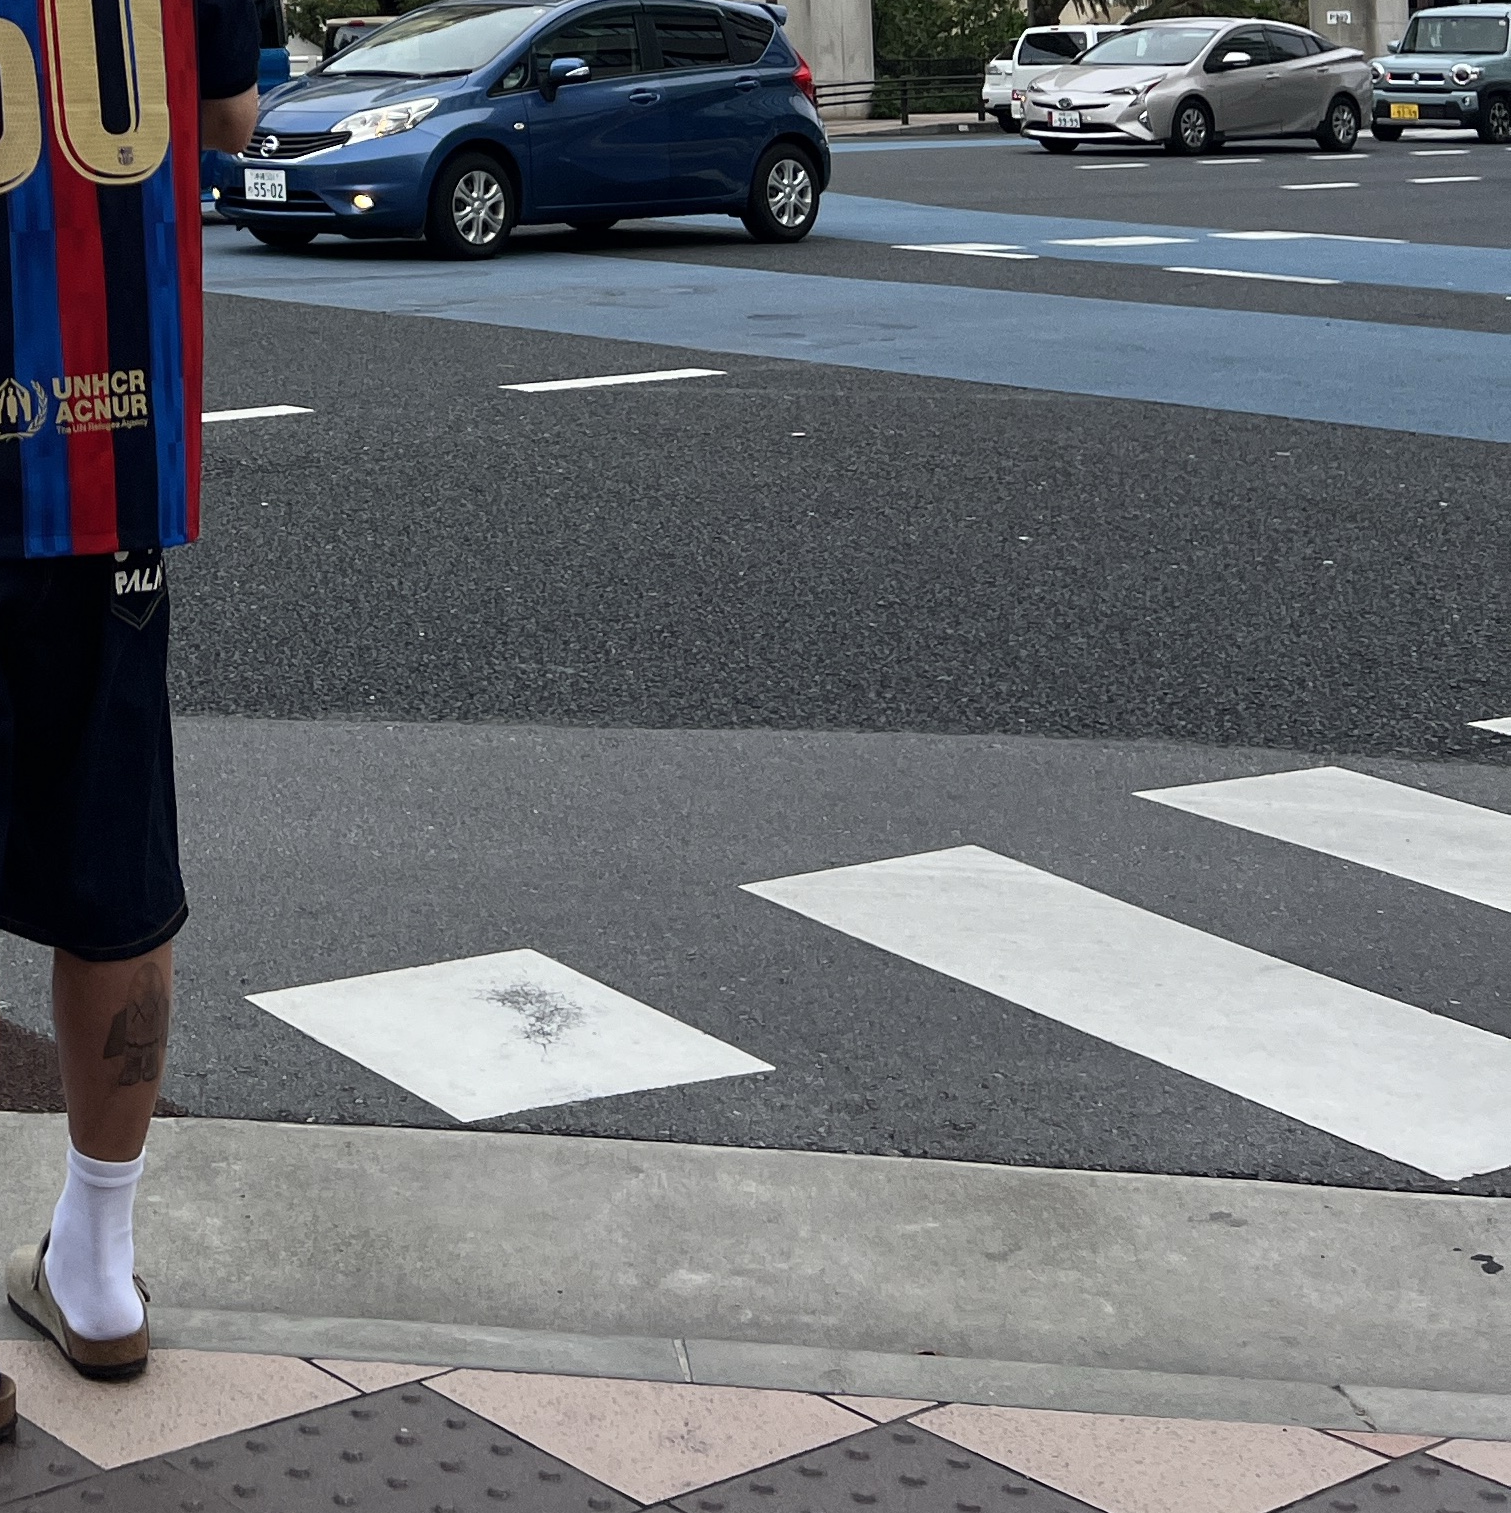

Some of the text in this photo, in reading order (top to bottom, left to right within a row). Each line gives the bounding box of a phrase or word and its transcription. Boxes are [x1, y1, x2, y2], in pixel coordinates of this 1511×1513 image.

[253, 182, 284, 199] 55-02
[52, 369, 146, 400] UNHCR
[55, 393, 148, 424] ACNUR
